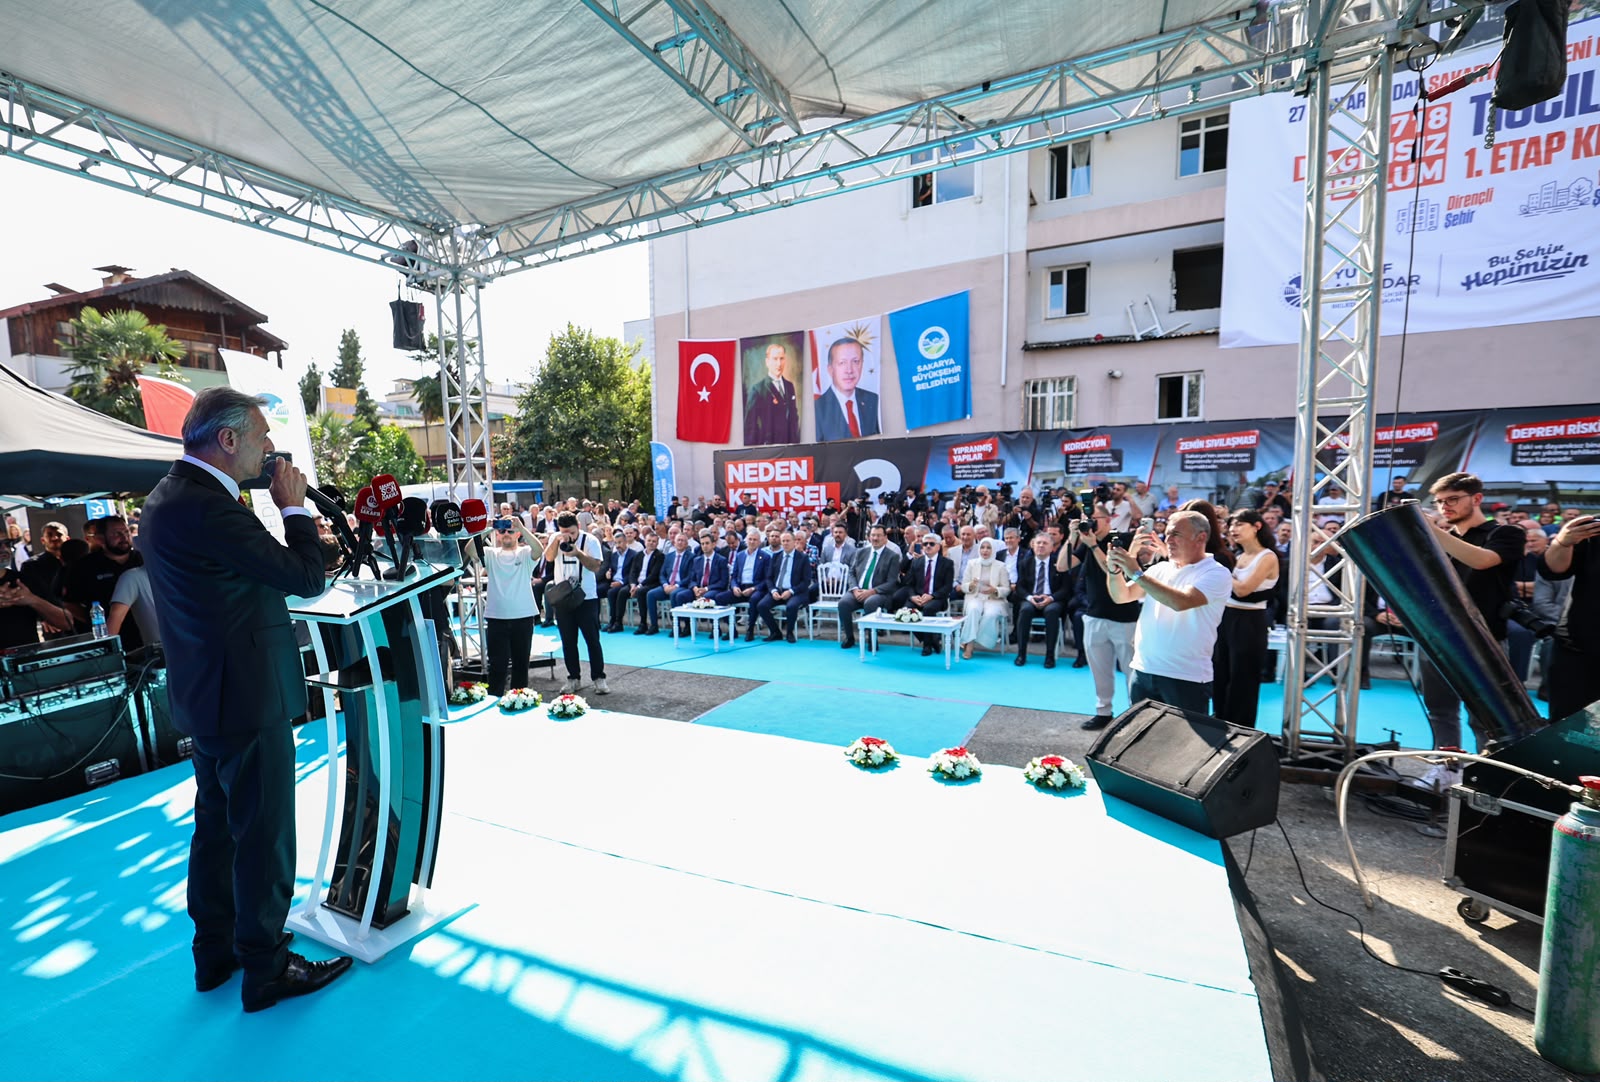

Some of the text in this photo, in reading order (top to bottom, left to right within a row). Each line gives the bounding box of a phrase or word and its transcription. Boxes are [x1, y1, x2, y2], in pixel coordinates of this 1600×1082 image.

[1465, 148, 1483, 179] 1.
[1490, 131, 1566, 175] ETAP
[1447, 187, 1494, 211] Dirençli
[1444, 209, 1475, 229] Şehir
[1488, 244, 1564, 268] Bu Şehir
[1461, 252, 1589, 291] Hepimizin
[912, 365, 961, 382] BÜYÜKŞEHİR
[917, 358, 955, 372] SAKARYA
[916, 374, 960, 391] BELEDİYESİ
[1511, 425, 1565, 439] DEPREM
[952, 443, 992, 454] YIPRANMIŞ
[1064, 438, 1107, 451] KOROZYON
[1180, 435, 1257, 450] ZEMİN SIVILAŞMASI
[952, 453, 983, 462] YAPILAR
[728, 460, 807, 483] NEDEN
